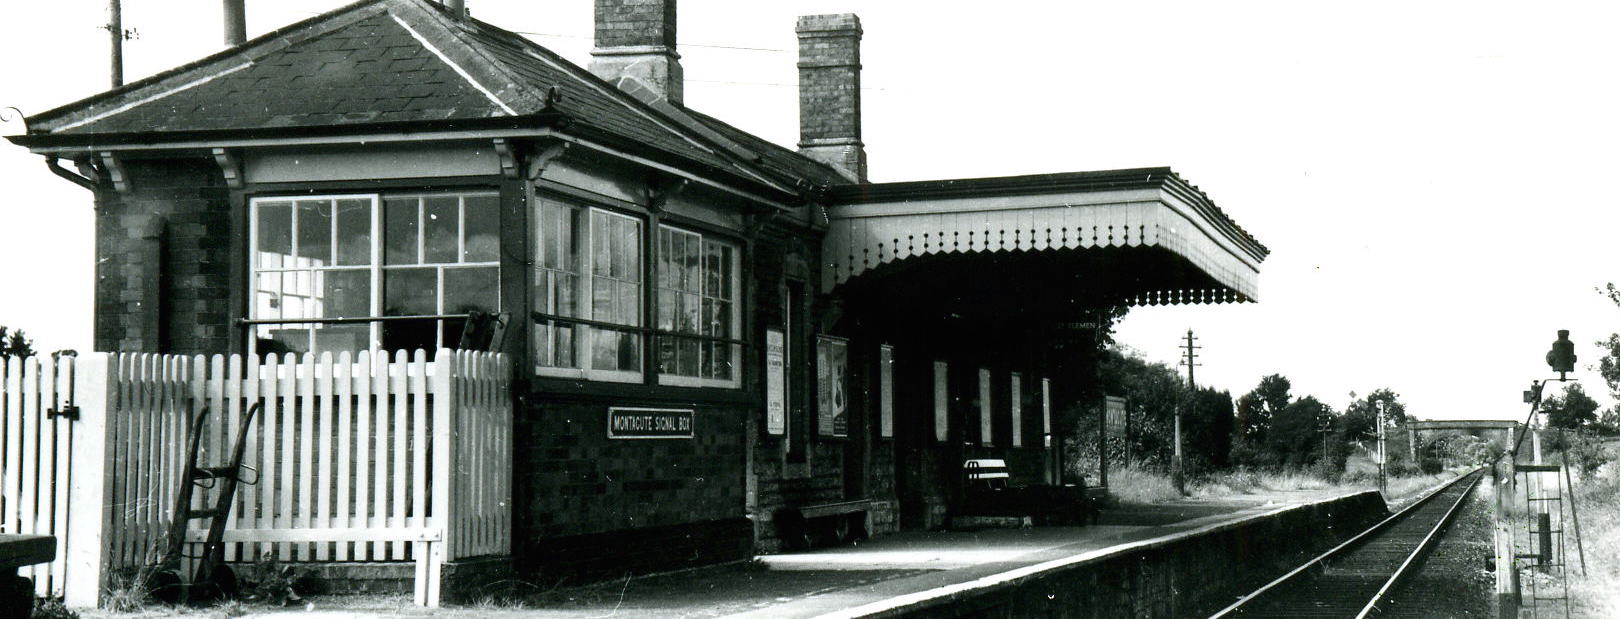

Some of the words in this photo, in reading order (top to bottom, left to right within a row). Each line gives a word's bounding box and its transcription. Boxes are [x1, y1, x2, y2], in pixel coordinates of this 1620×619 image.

[614, 415, 652, 431] MONTACUTE
[655, 416, 676, 431] SIGNAL
[679, 417, 690, 431] BOX
